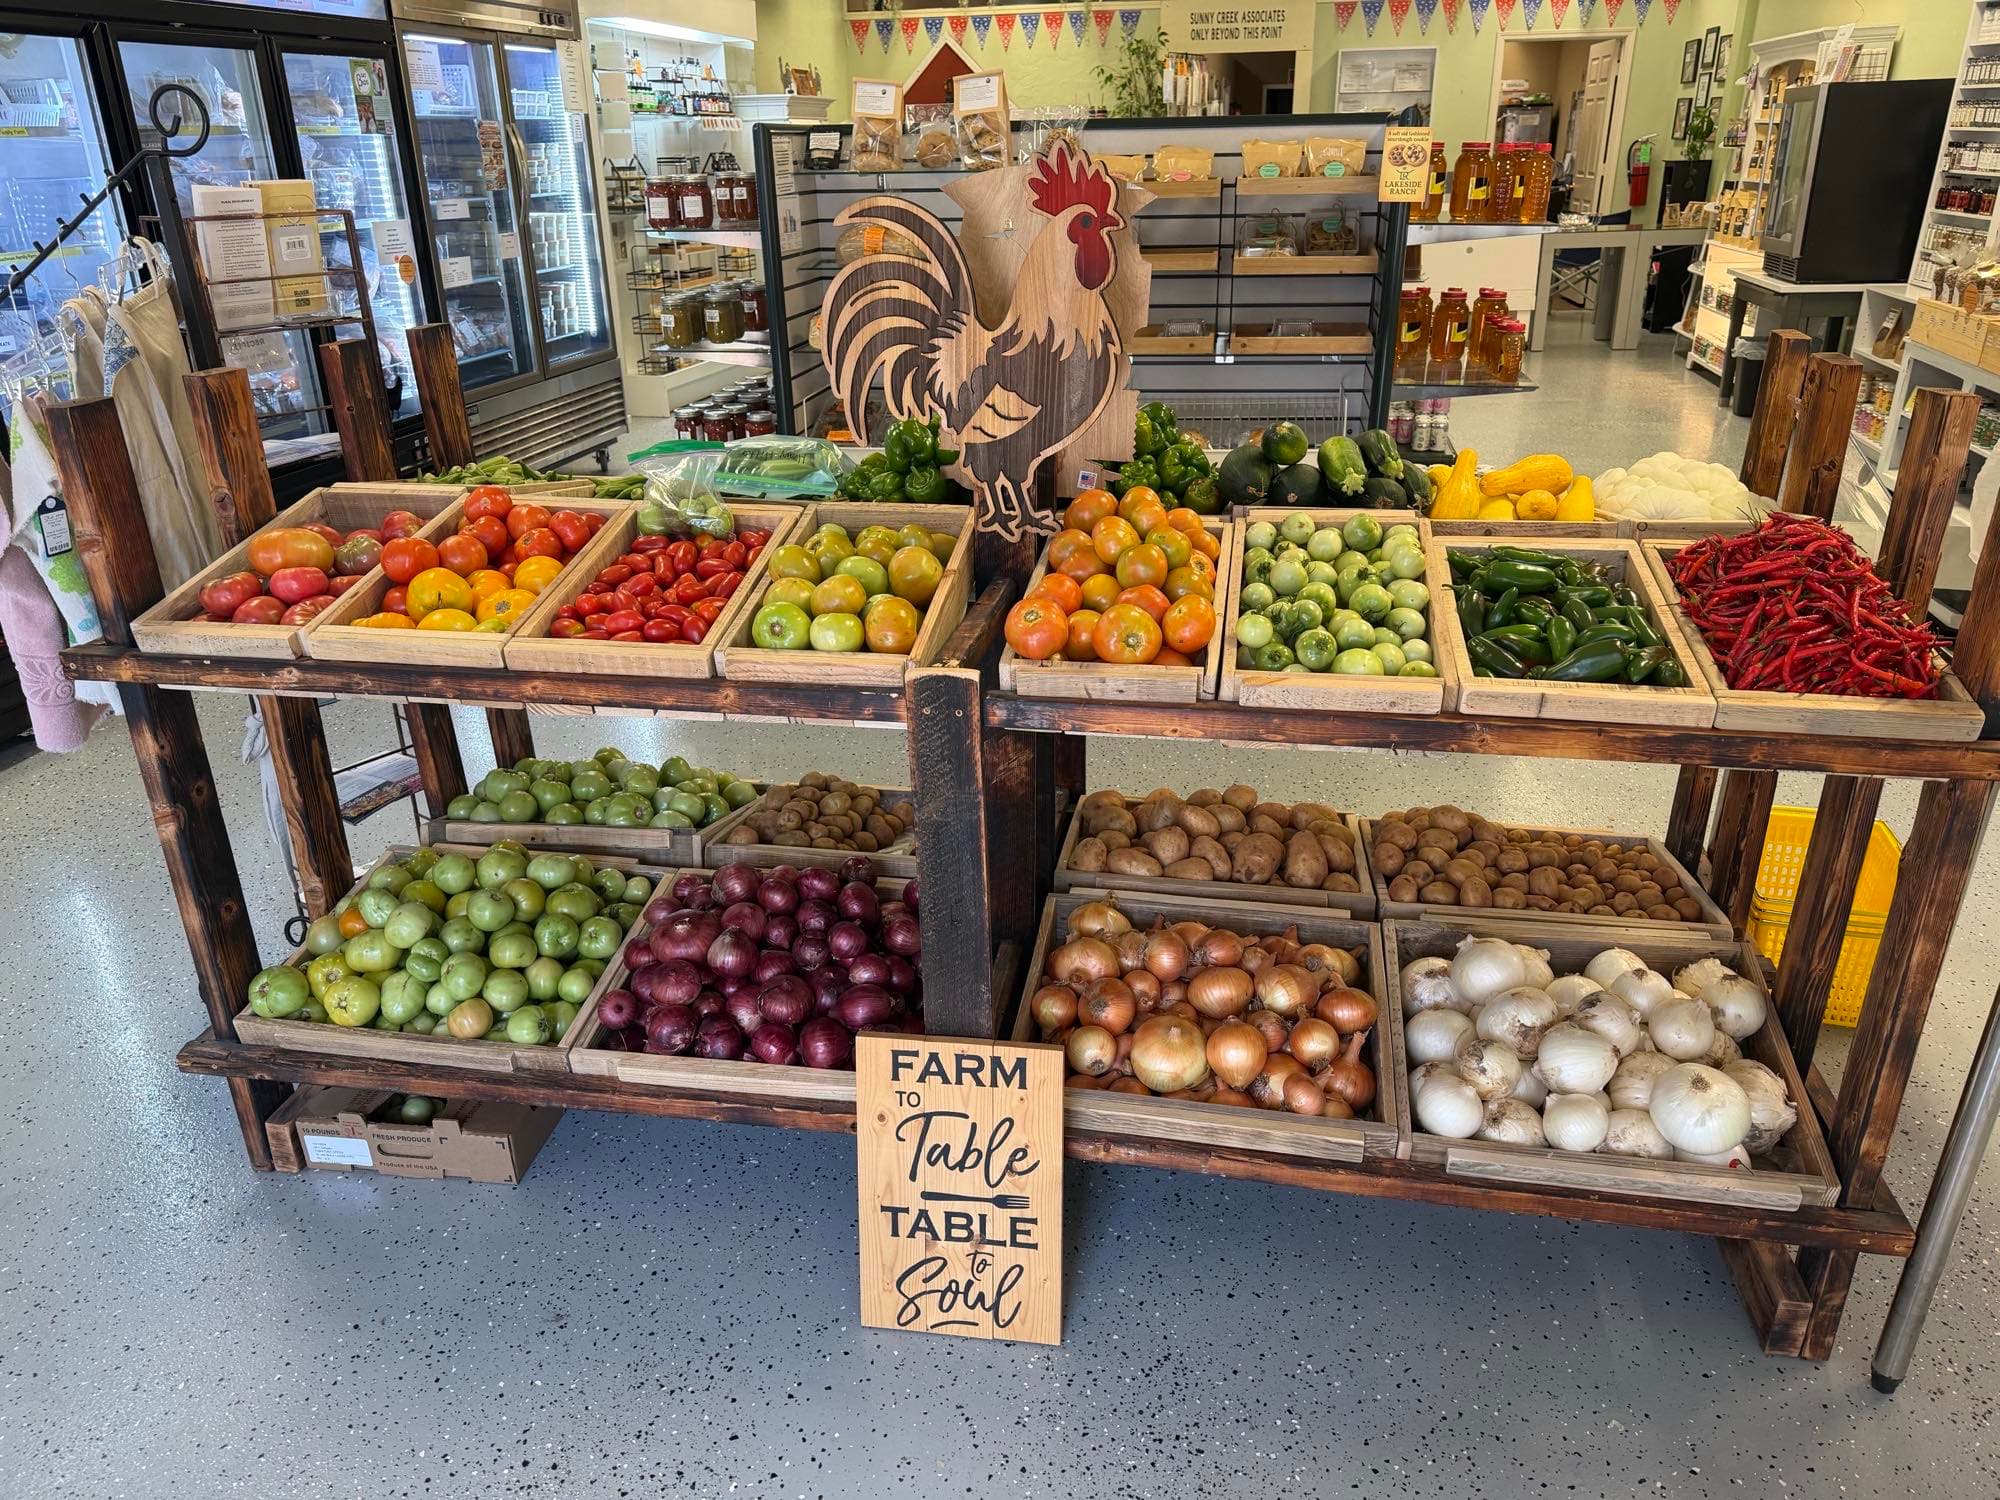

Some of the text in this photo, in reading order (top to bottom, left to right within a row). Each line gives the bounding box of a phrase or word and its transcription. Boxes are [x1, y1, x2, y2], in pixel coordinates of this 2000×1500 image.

[1190, 9, 1286, 24] SUNNY CREEK ASSOCIATES
[1190, 26, 1283, 41] ONLY BEYOND THIS POINT
[889, 1048, 1028, 1090] FARM
[895, 1091, 921, 1108] TO
[311, 1128, 341, 1136] POUNDS
[372, 1133, 432, 1143] FRESH PRODUCE
[895, 1110, 1041, 1190] Table
[880, 1204, 1039, 1251] TABLE
[966, 1249, 995, 1281] to
[895, 1255, 1025, 1329] Soul
